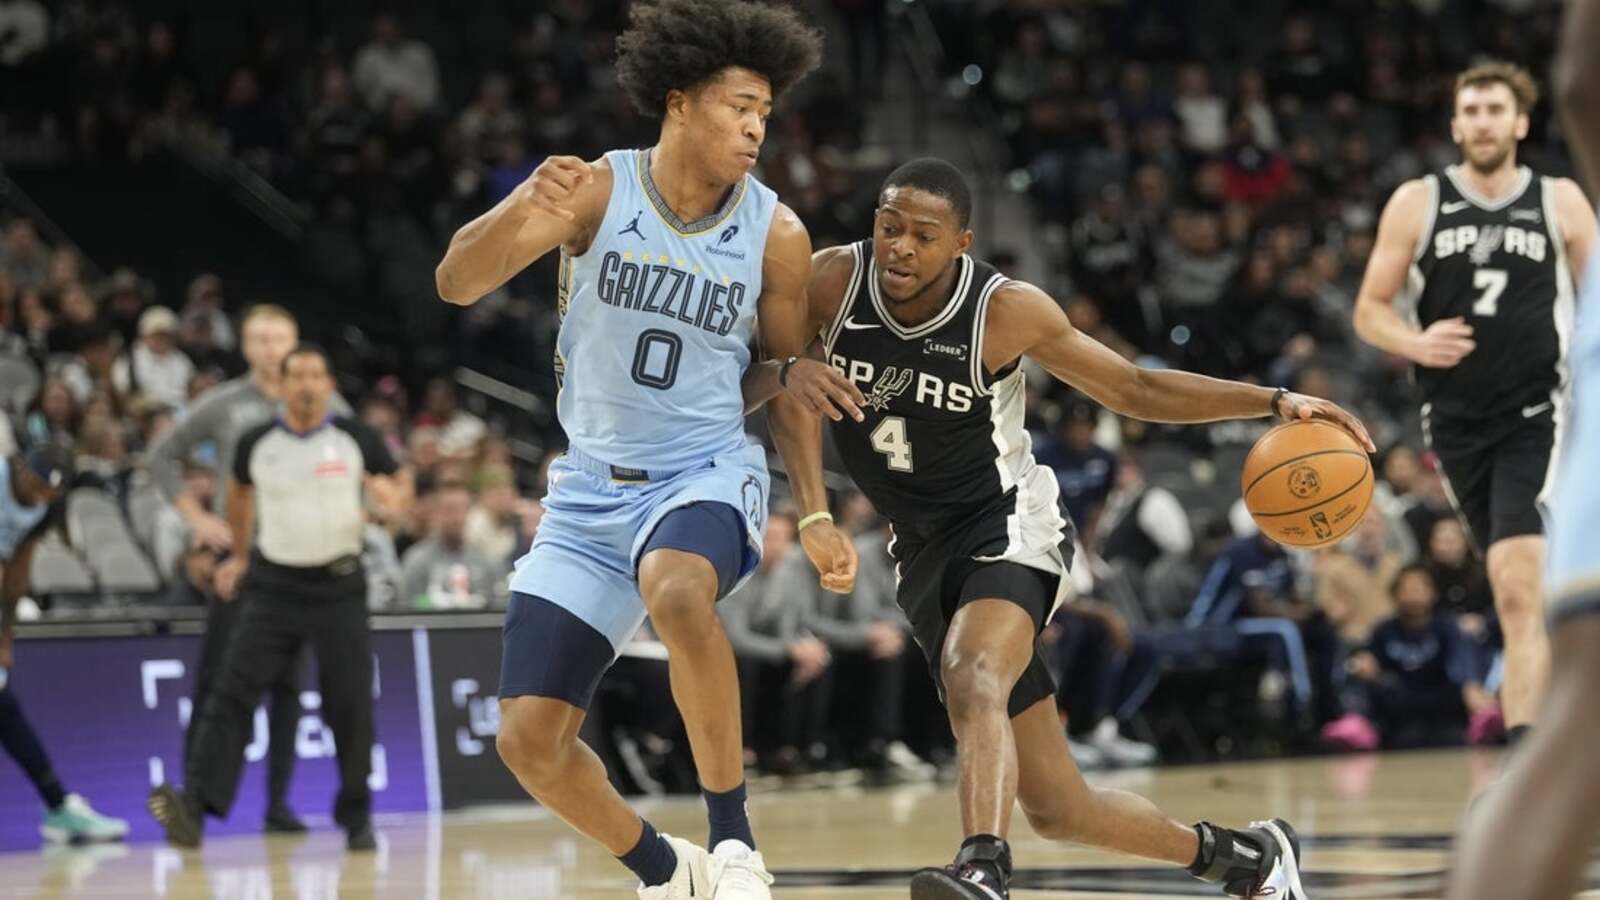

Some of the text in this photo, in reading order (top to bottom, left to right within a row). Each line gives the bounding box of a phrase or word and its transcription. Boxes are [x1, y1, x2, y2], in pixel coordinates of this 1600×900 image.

[705, 245, 746, 261] Robinhood
[598, 251, 746, 337] GRIZZLIES
[1472, 268, 1509, 317] 7
[630, 327, 684, 391] 0
[928, 342, 963, 356] LEDGER
[869, 416, 914, 473] 4
